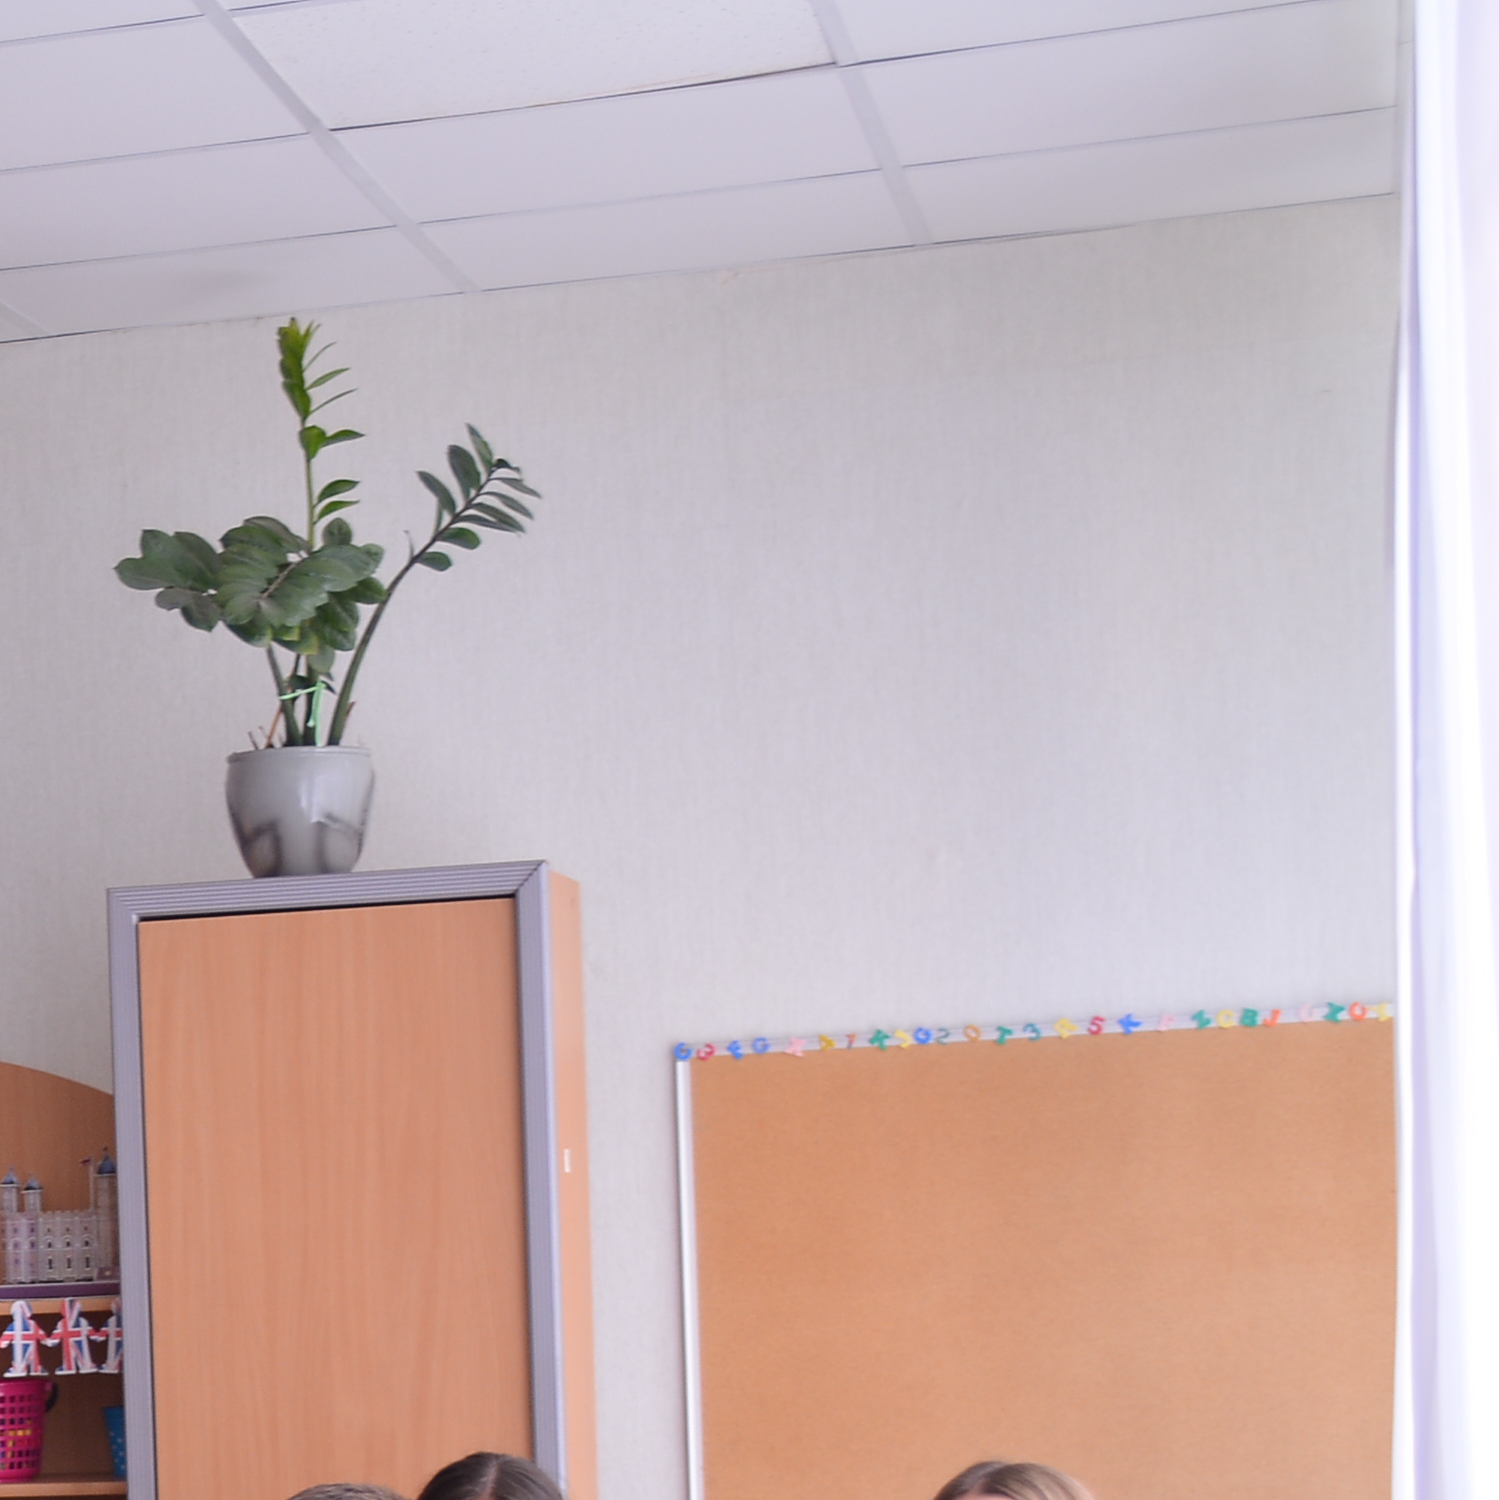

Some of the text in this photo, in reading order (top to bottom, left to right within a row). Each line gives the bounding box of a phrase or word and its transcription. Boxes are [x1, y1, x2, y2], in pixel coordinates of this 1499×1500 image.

[1023, 1023, 1041, 1040] 3
[1087, 1016, 1105, 1035] 5
[1216, 1010, 1234, 1028] C
[1240, 1007, 1258, 1026] B
[1263, 1009, 1281, 1026] J
